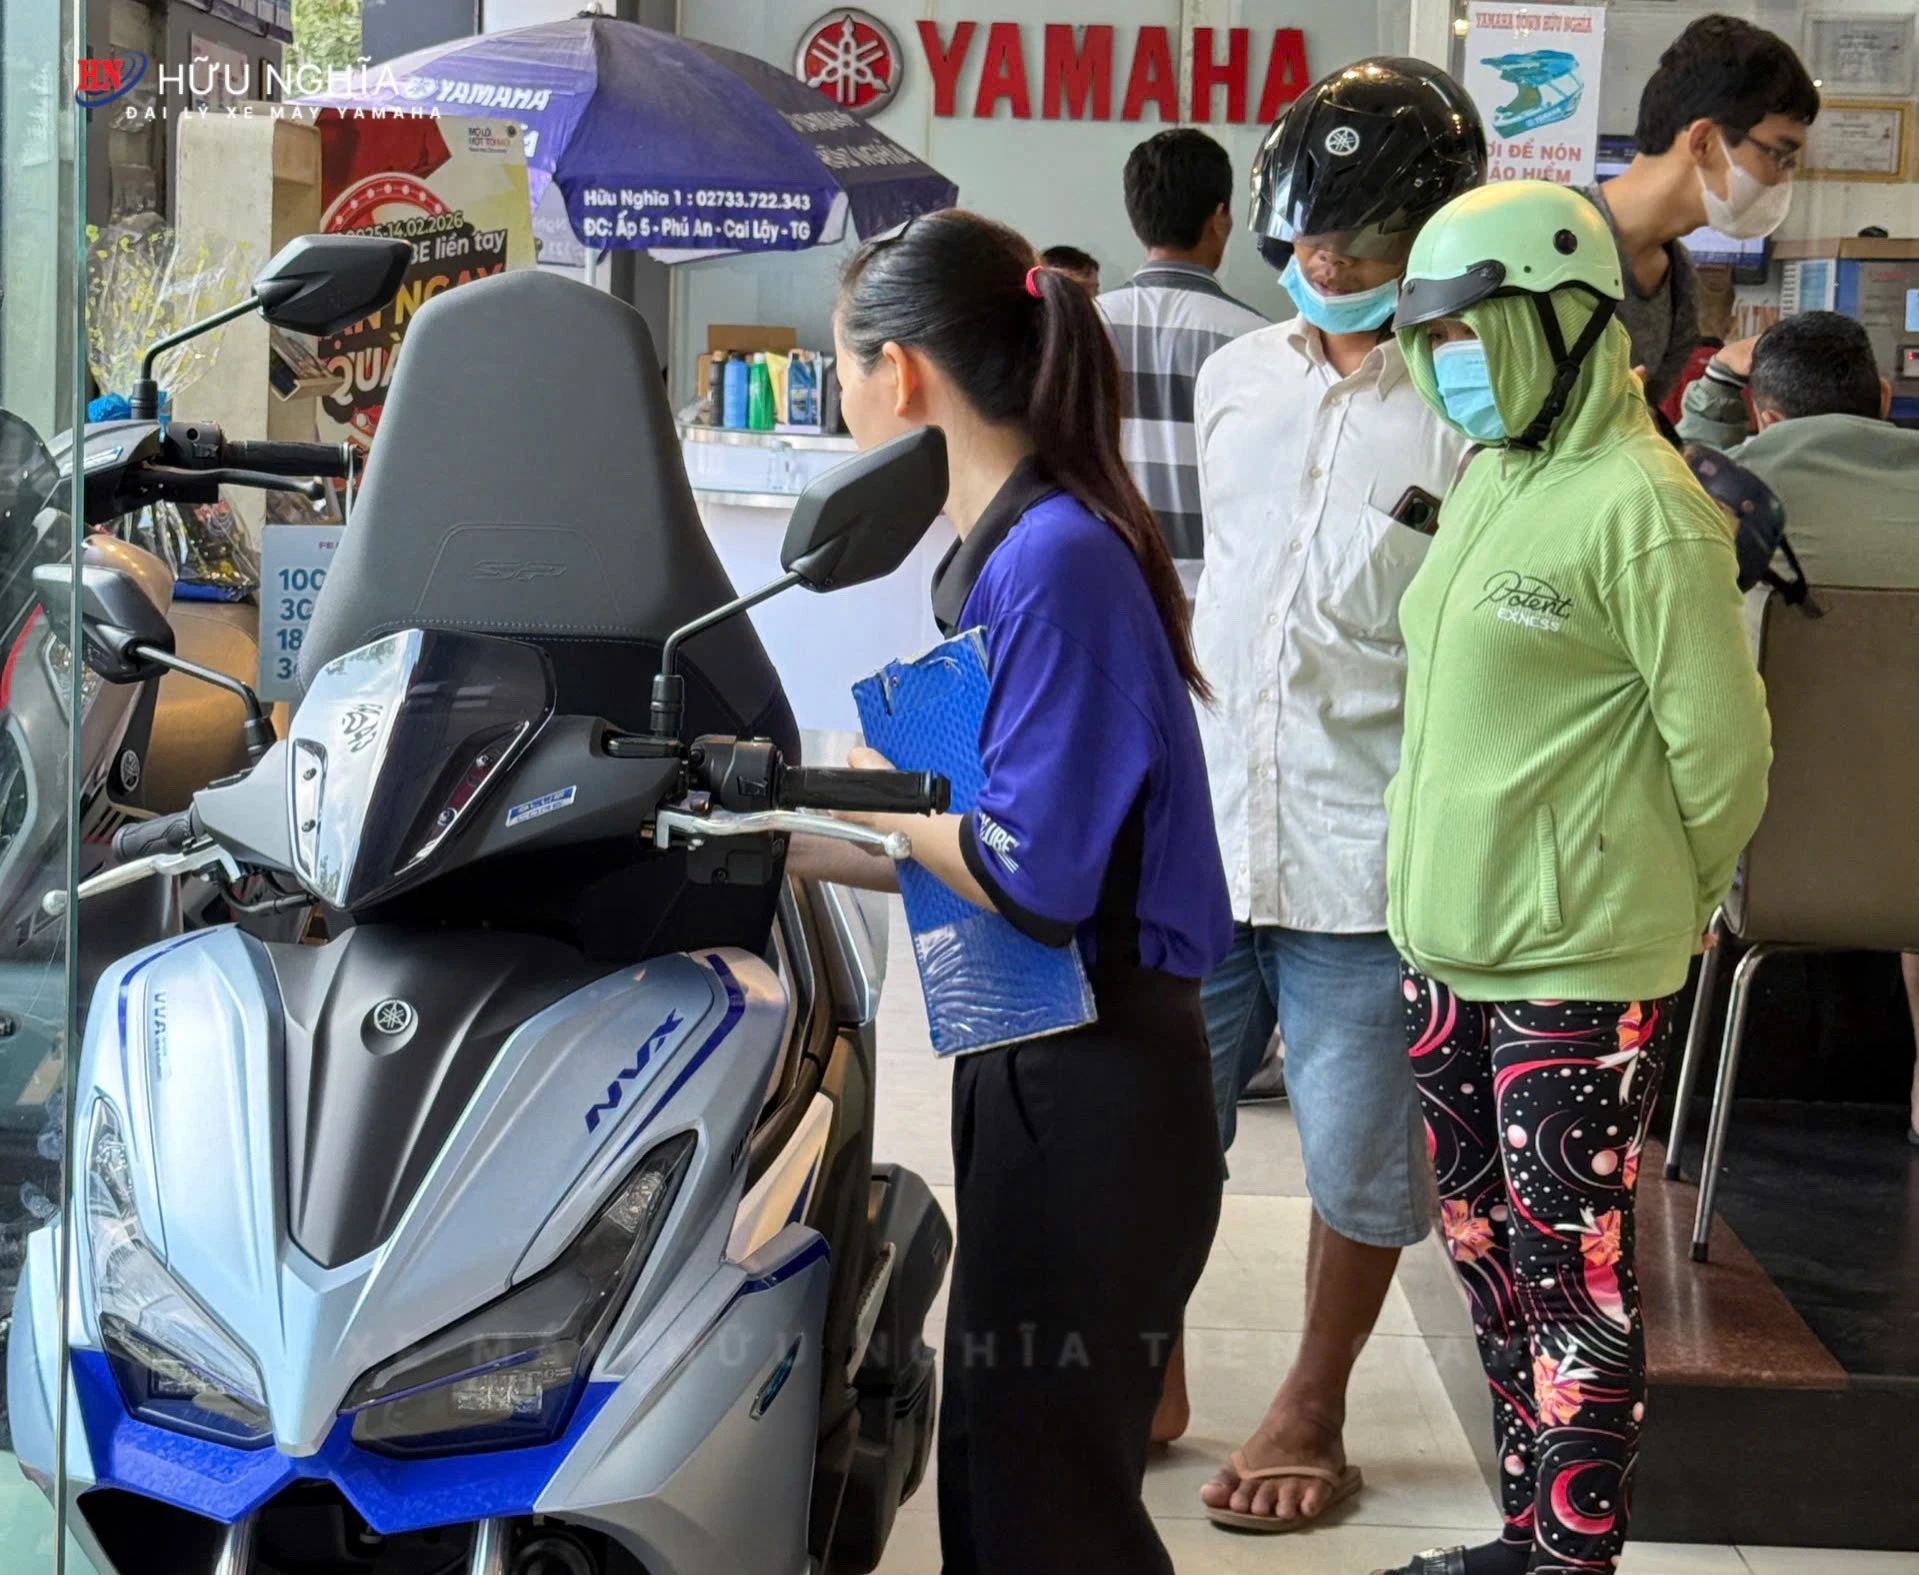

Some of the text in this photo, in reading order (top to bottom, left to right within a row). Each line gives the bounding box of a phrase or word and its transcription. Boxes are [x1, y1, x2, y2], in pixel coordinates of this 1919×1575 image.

[916, 20, 1311, 124] YAMAHA
[436, 79, 552, 111] YAMAHA
[1540, 143, 1581, 161] NÓN
[584, 190, 616, 206] Hữu
[620, 190, 669, 210] Nghĩa
[674, 190, 682, 206] 1
[696, 190, 811, 210] 02733.722.343
[583, 217, 613, 237] ĐC:
[616, 210, 637, 240] Ấp
[640, 218, 650, 237] 5
[661, 216, 689, 237] Phú
[693, 220, 713, 237] An
[723, 220, 749, 238] Cai
[752, 220, 780, 244] Lậy
[790, 221, 811, 240] TG
[435, 232, 469, 260] liền
[474, 230, 506, 254] tay
[1472, 570, 1574, 620] Potent
[277, 657, 297, 680] 3
[585, 1007, 684, 1134] NVX
